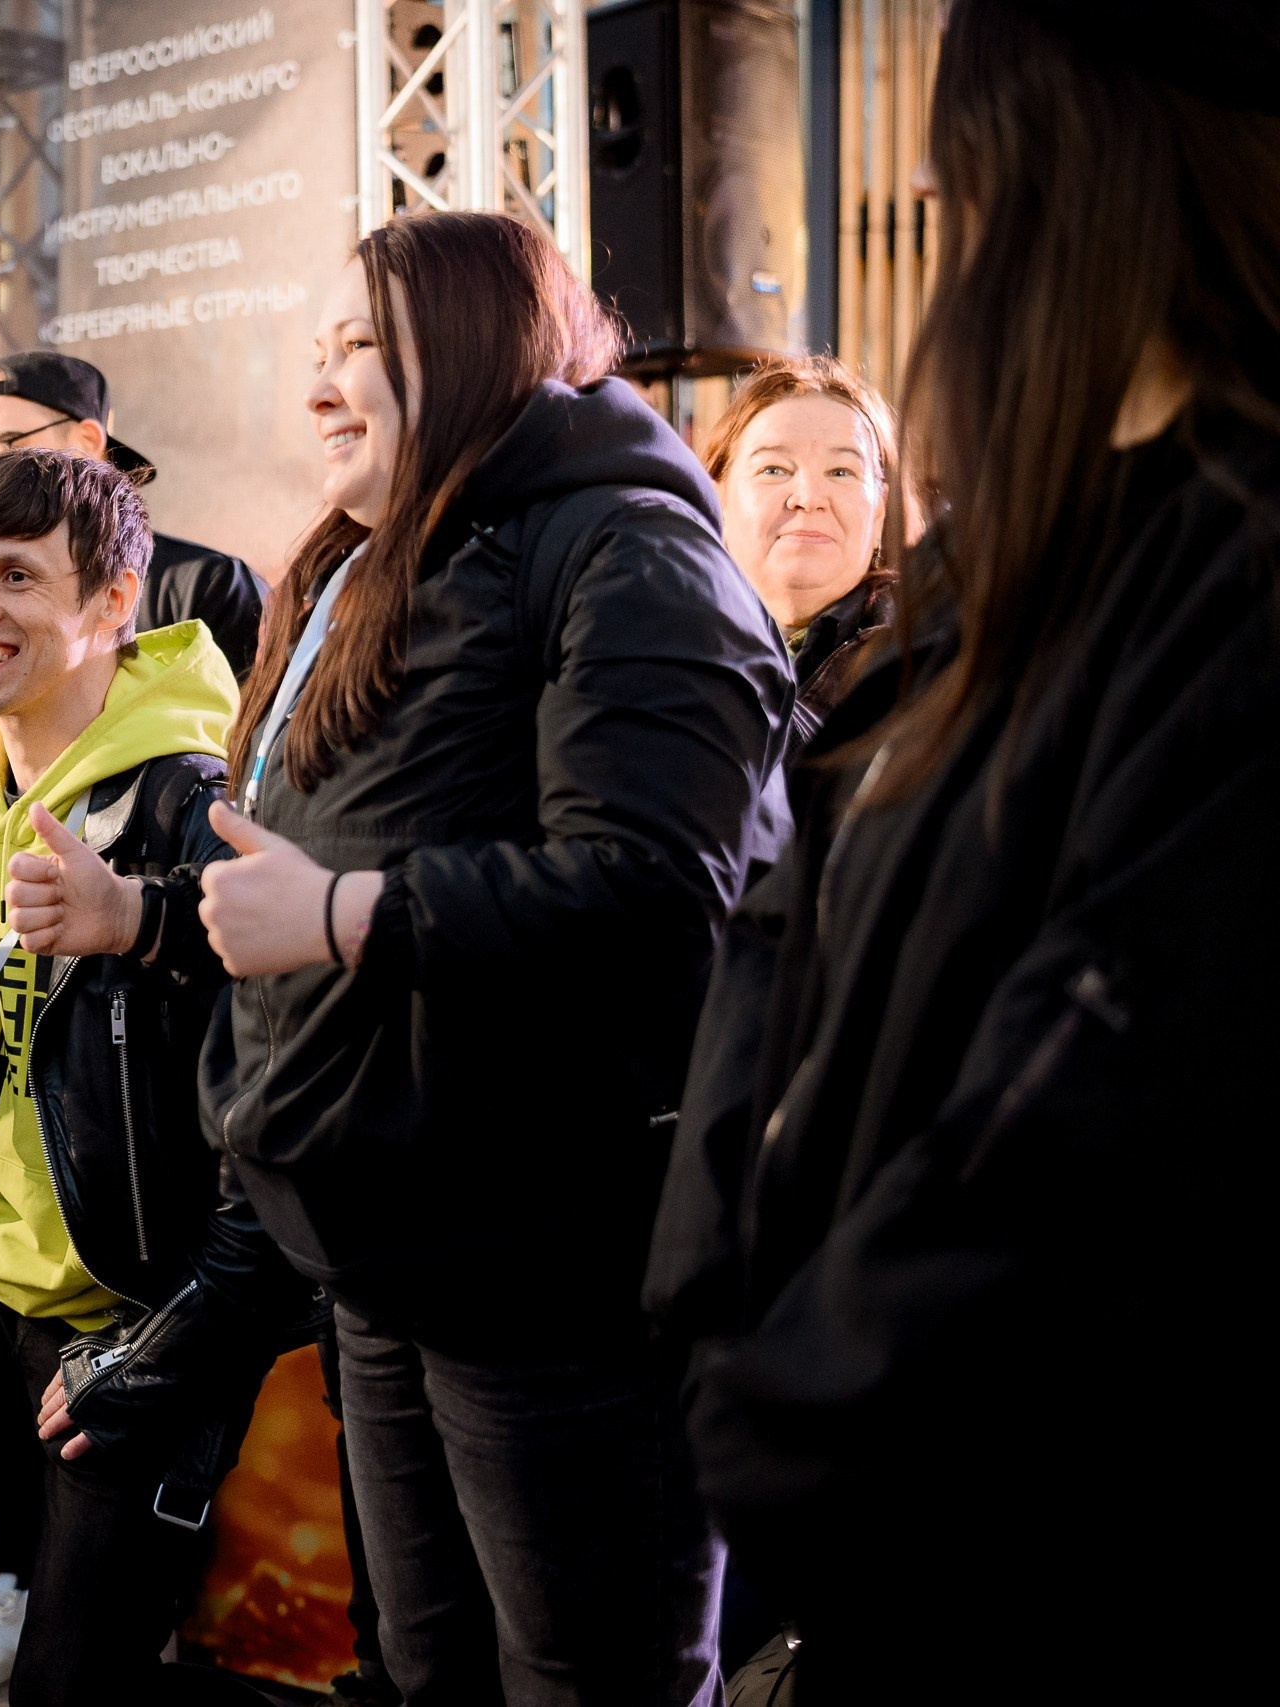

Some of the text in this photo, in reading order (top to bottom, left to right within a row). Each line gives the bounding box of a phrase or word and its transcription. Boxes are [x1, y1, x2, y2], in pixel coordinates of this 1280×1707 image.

[68, 8, 275, 90] ВСЕРОССИЙСКИЙ
[100, 130, 235, 185] ВОКАЛЬНО-
[94, 236, 242, 287] ТВОРЧЕСТВА
